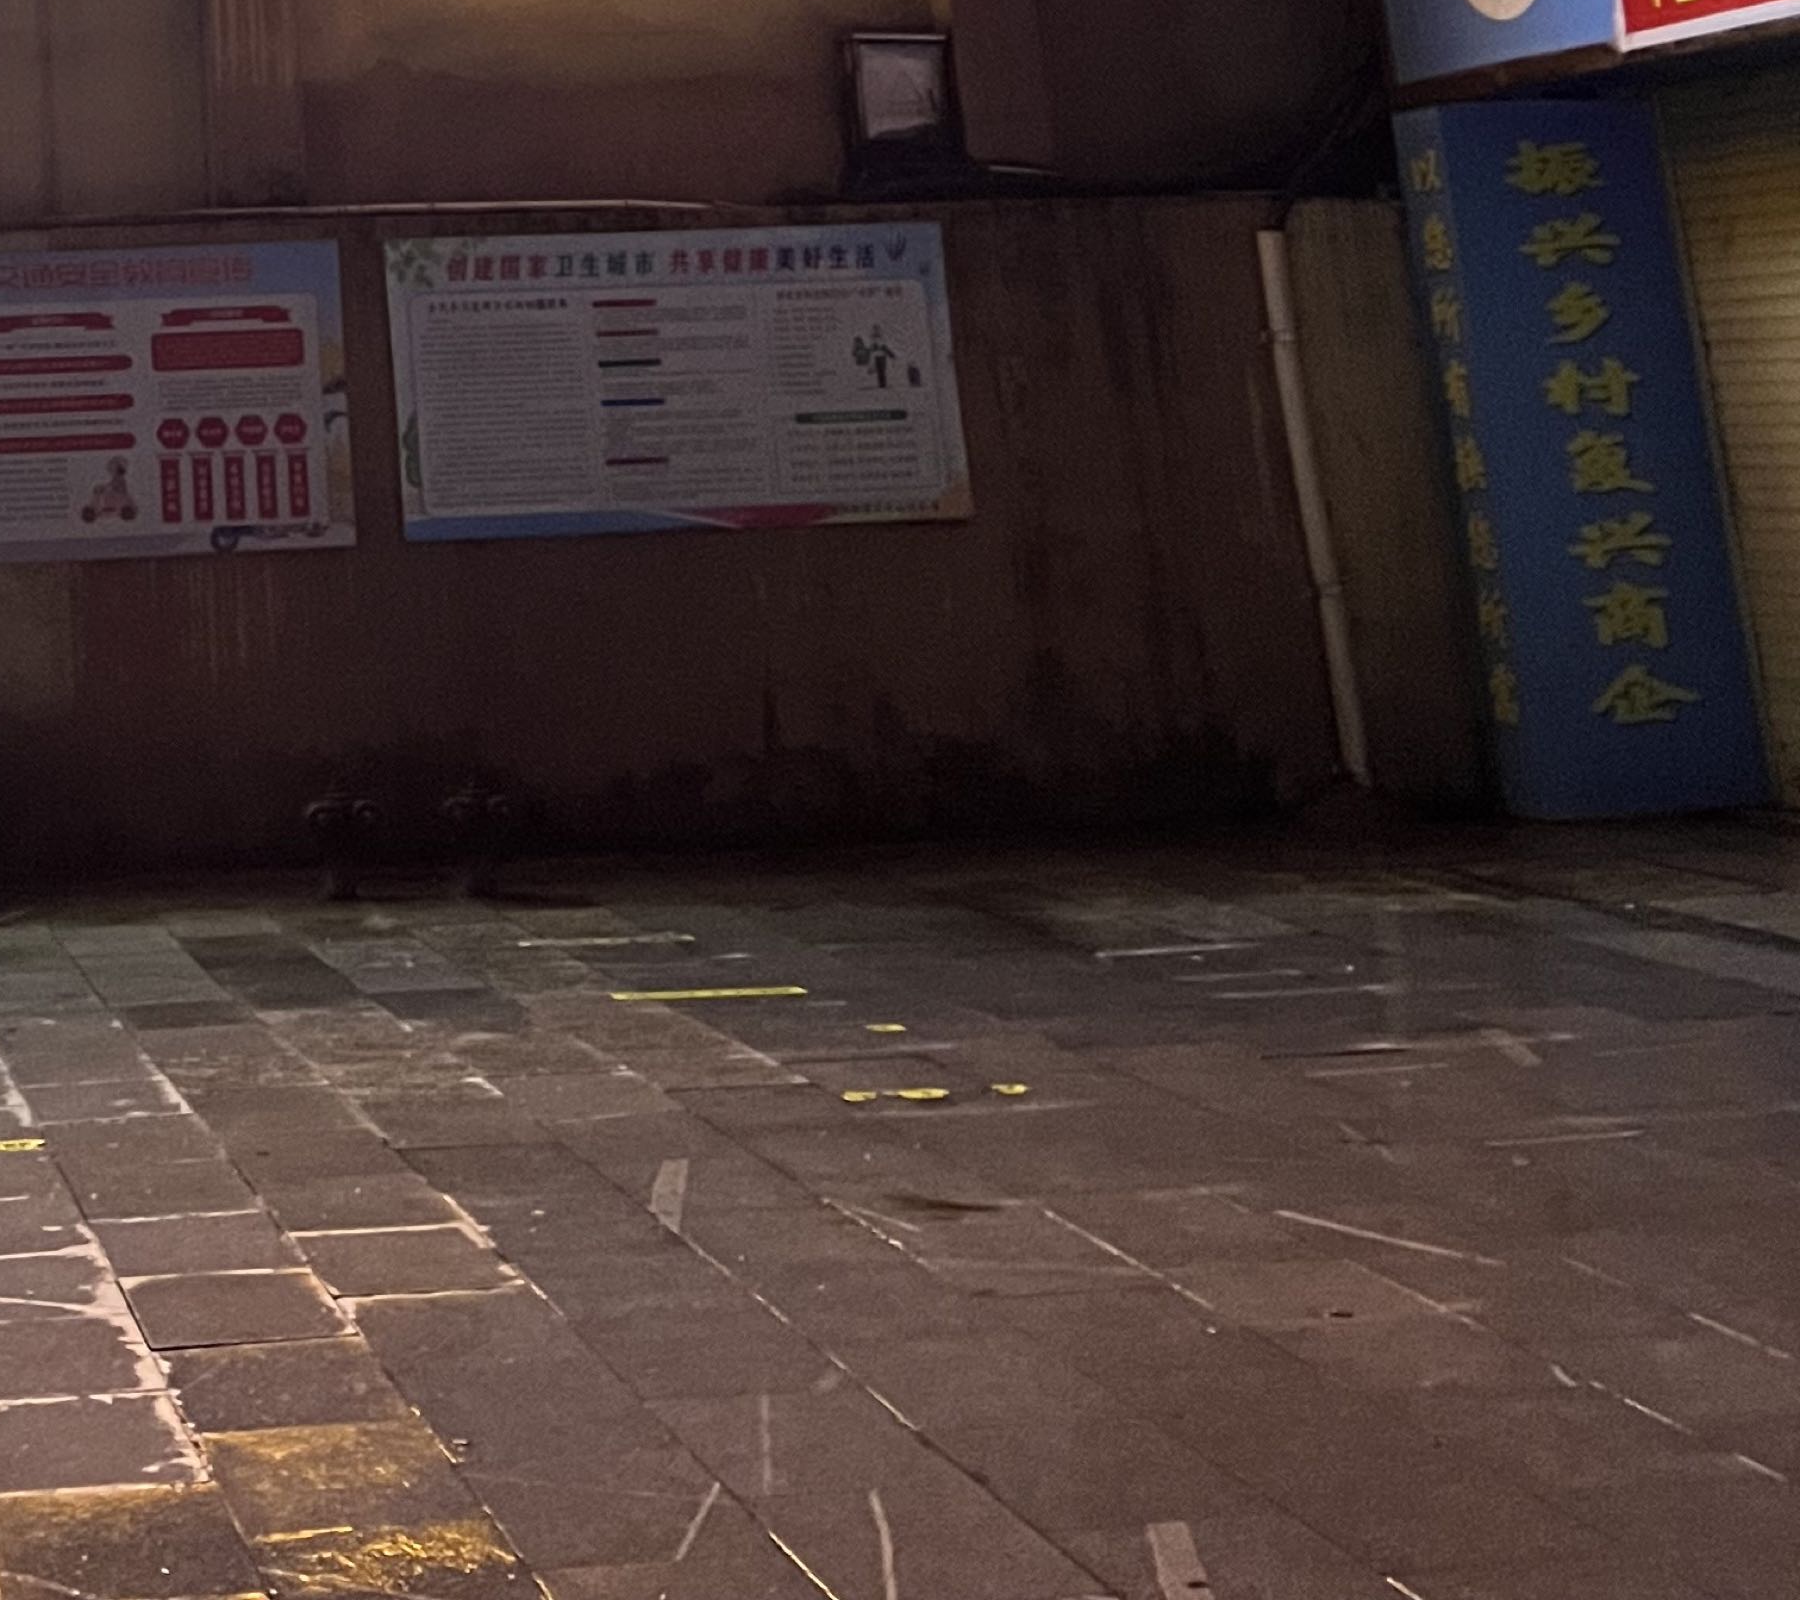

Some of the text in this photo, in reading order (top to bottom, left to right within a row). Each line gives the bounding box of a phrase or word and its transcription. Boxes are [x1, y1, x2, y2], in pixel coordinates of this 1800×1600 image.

[446, 244, 876, 283] 创建国家卫生城市 共享健康美好生活
